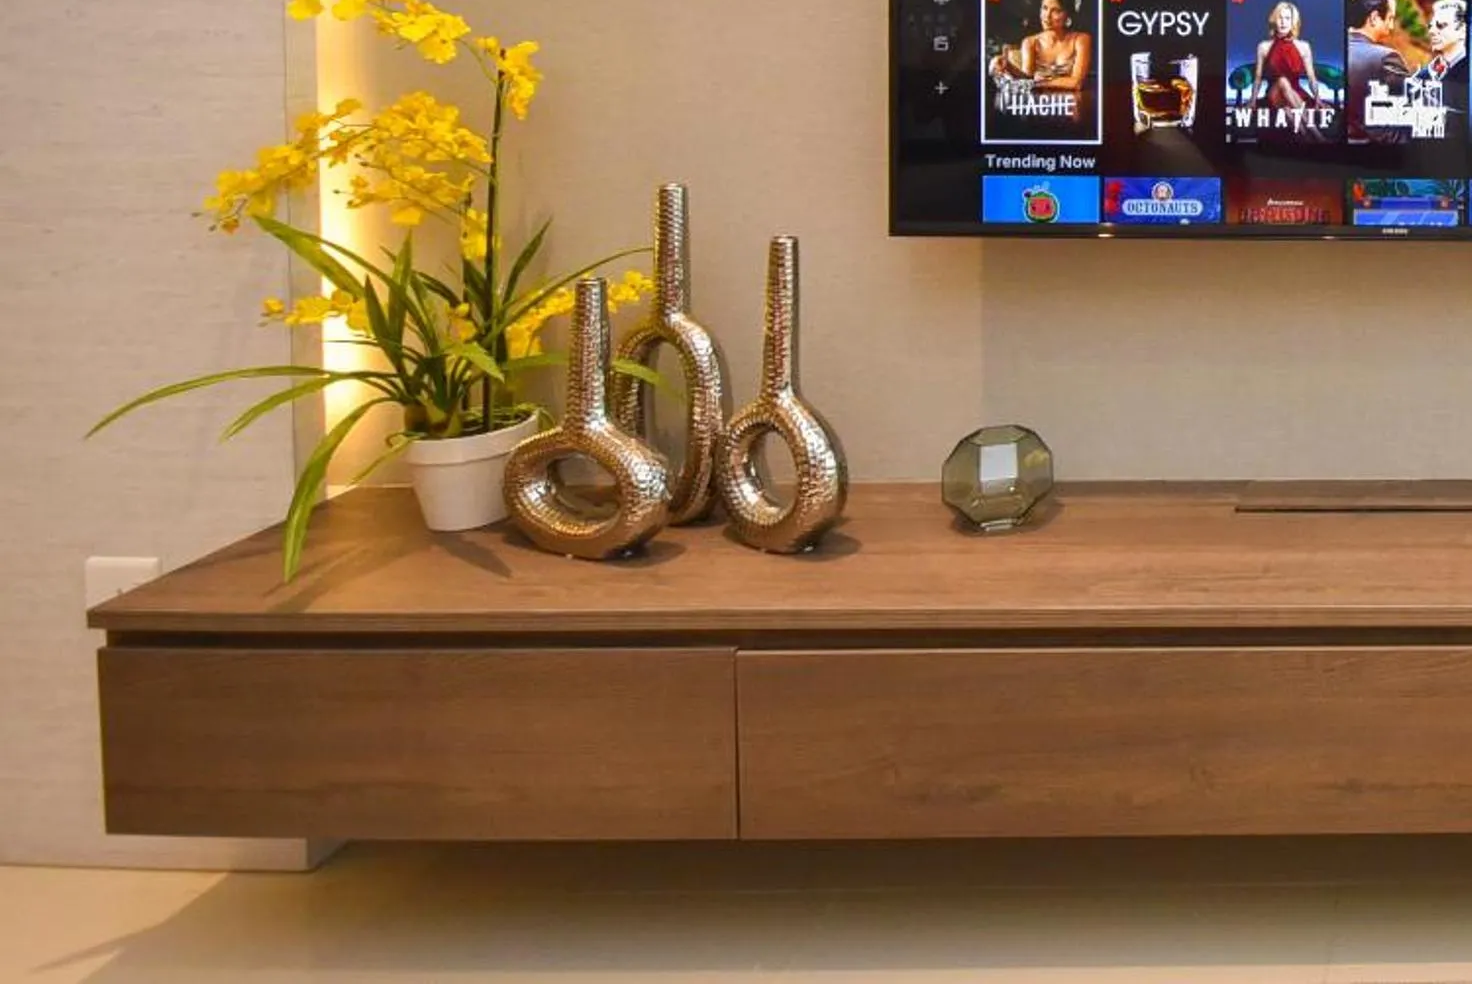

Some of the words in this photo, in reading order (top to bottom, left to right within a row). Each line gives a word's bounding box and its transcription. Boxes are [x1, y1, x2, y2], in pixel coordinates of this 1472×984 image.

[1117, 11, 1209, 36] GYPSY
[1006, 95, 1076, 116] HACHE
[985, 154, 1055, 172] Trending
[1060, 155, 1095, 168] Now
[1127, 200, 1199, 214] OCTONAUTS
